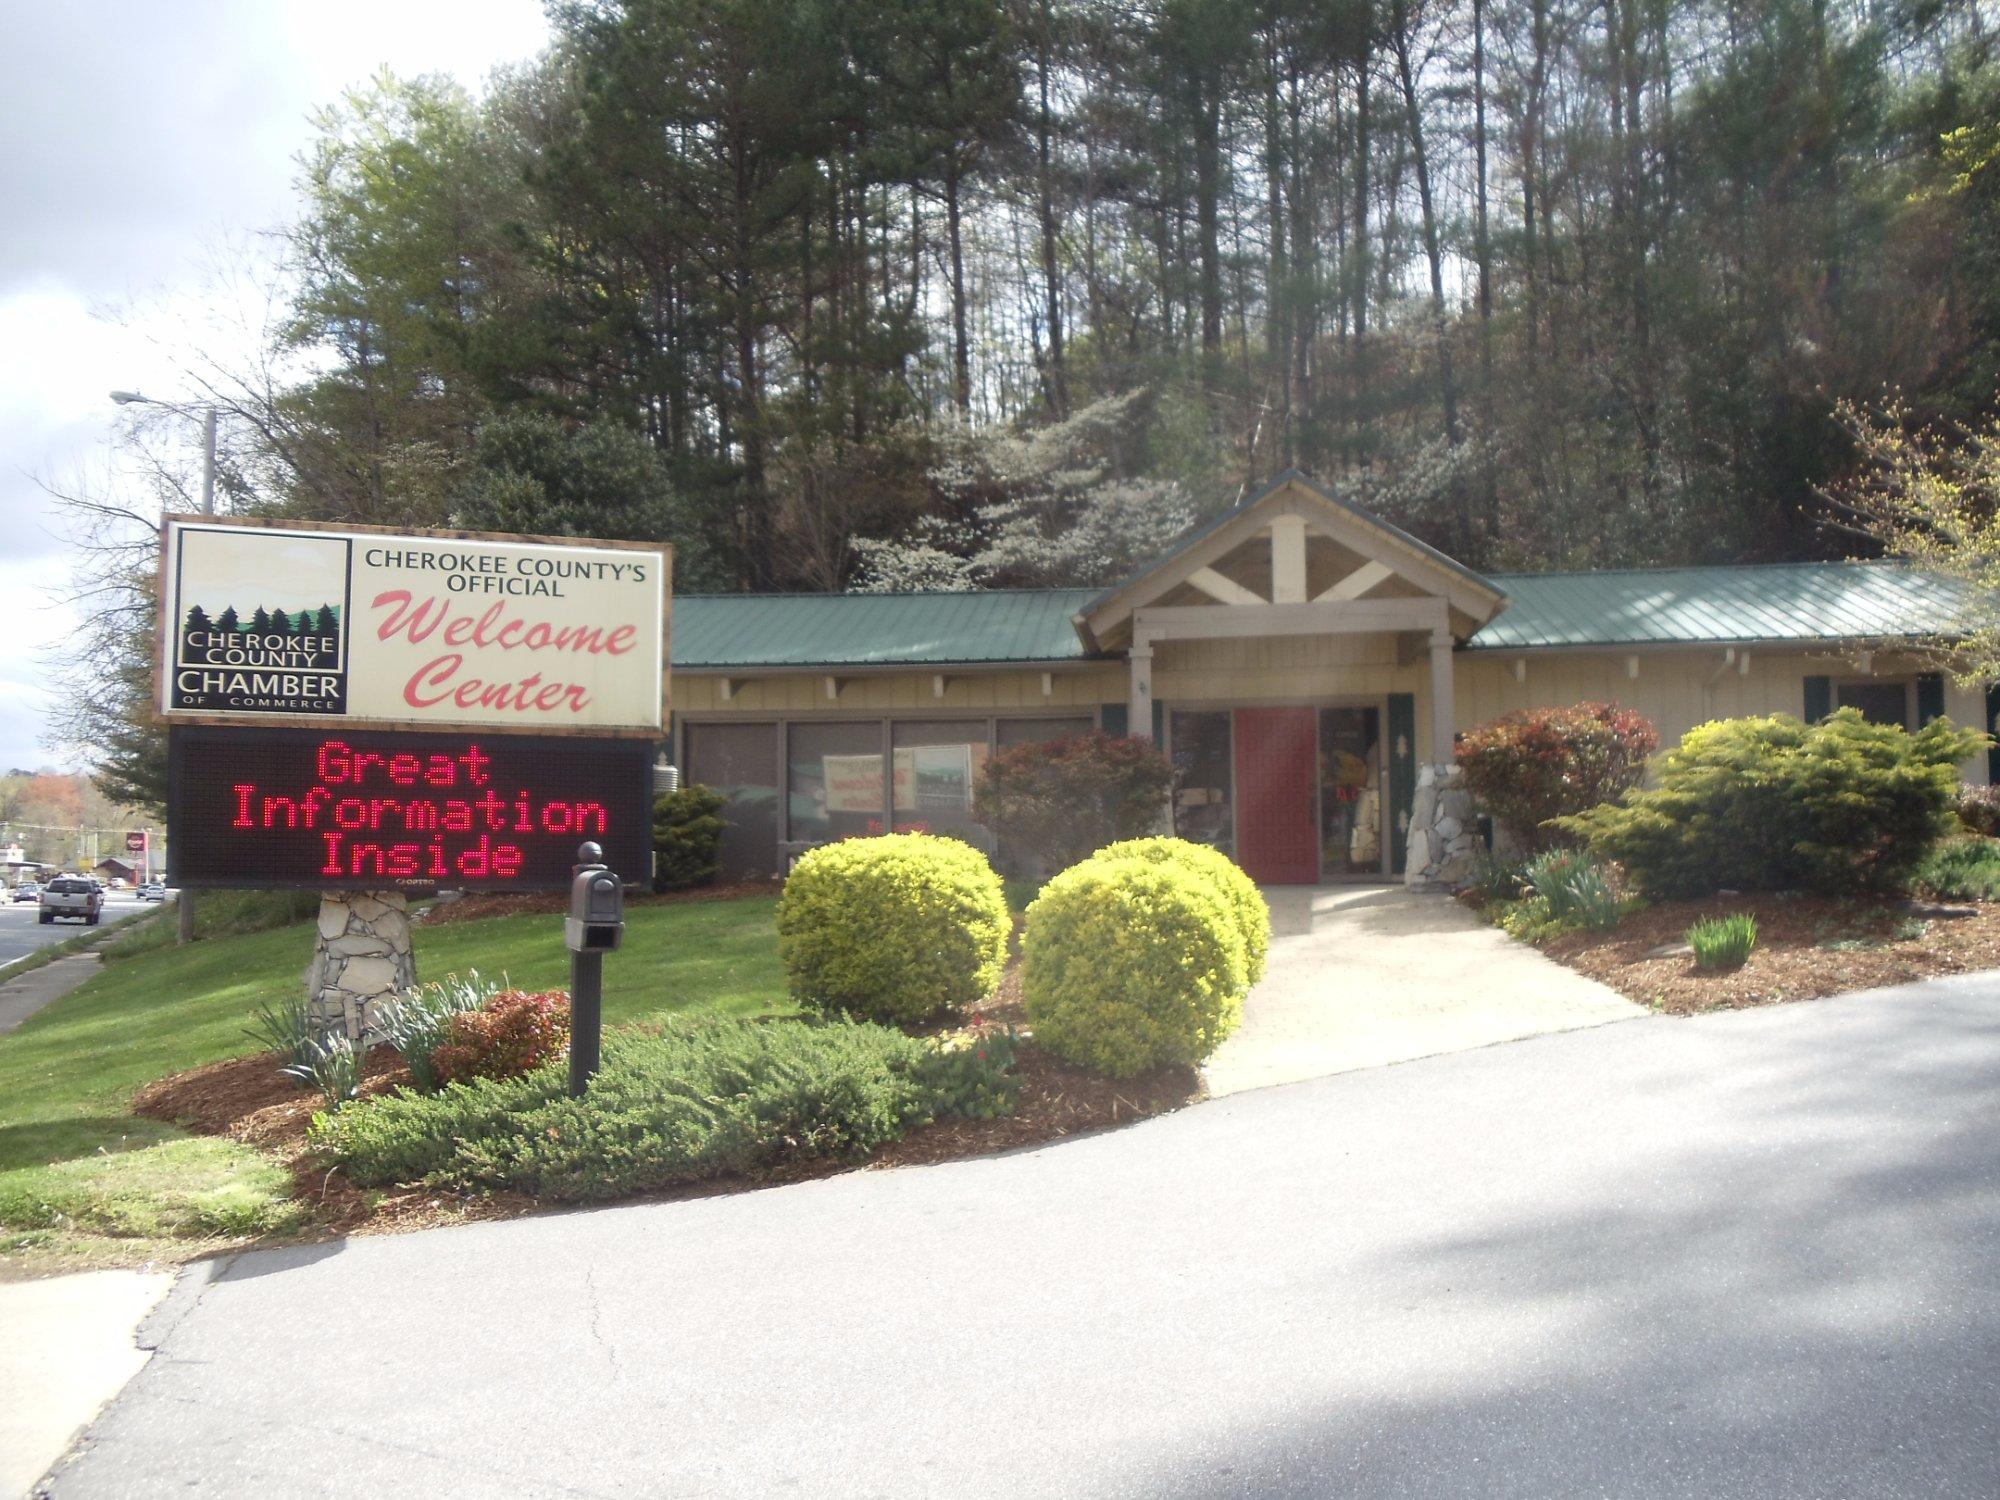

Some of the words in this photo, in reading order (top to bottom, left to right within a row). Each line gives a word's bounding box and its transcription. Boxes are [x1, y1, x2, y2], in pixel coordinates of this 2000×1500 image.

[365, 548, 508, 574] CHEROKEE
[516, 557, 647, 583] COUNTY'S
[446, 573, 565, 598] OFFICIAL
[370, 589, 638, 656] Welcome
[187, 631, 335, 653] CHEROKEE
[205, 648, 318, 668] COUNTY
[177, 670, 340, 698] CHAMBER
[402, 653, 592, 712] Center
[182, 695, 207, 704] OF
[230, 697, 335, 709] COMMERCE
[316, 740, 492, 786] Great
[232, 784, 609, 834] Information
[321, 831, 524, 877] Inside
